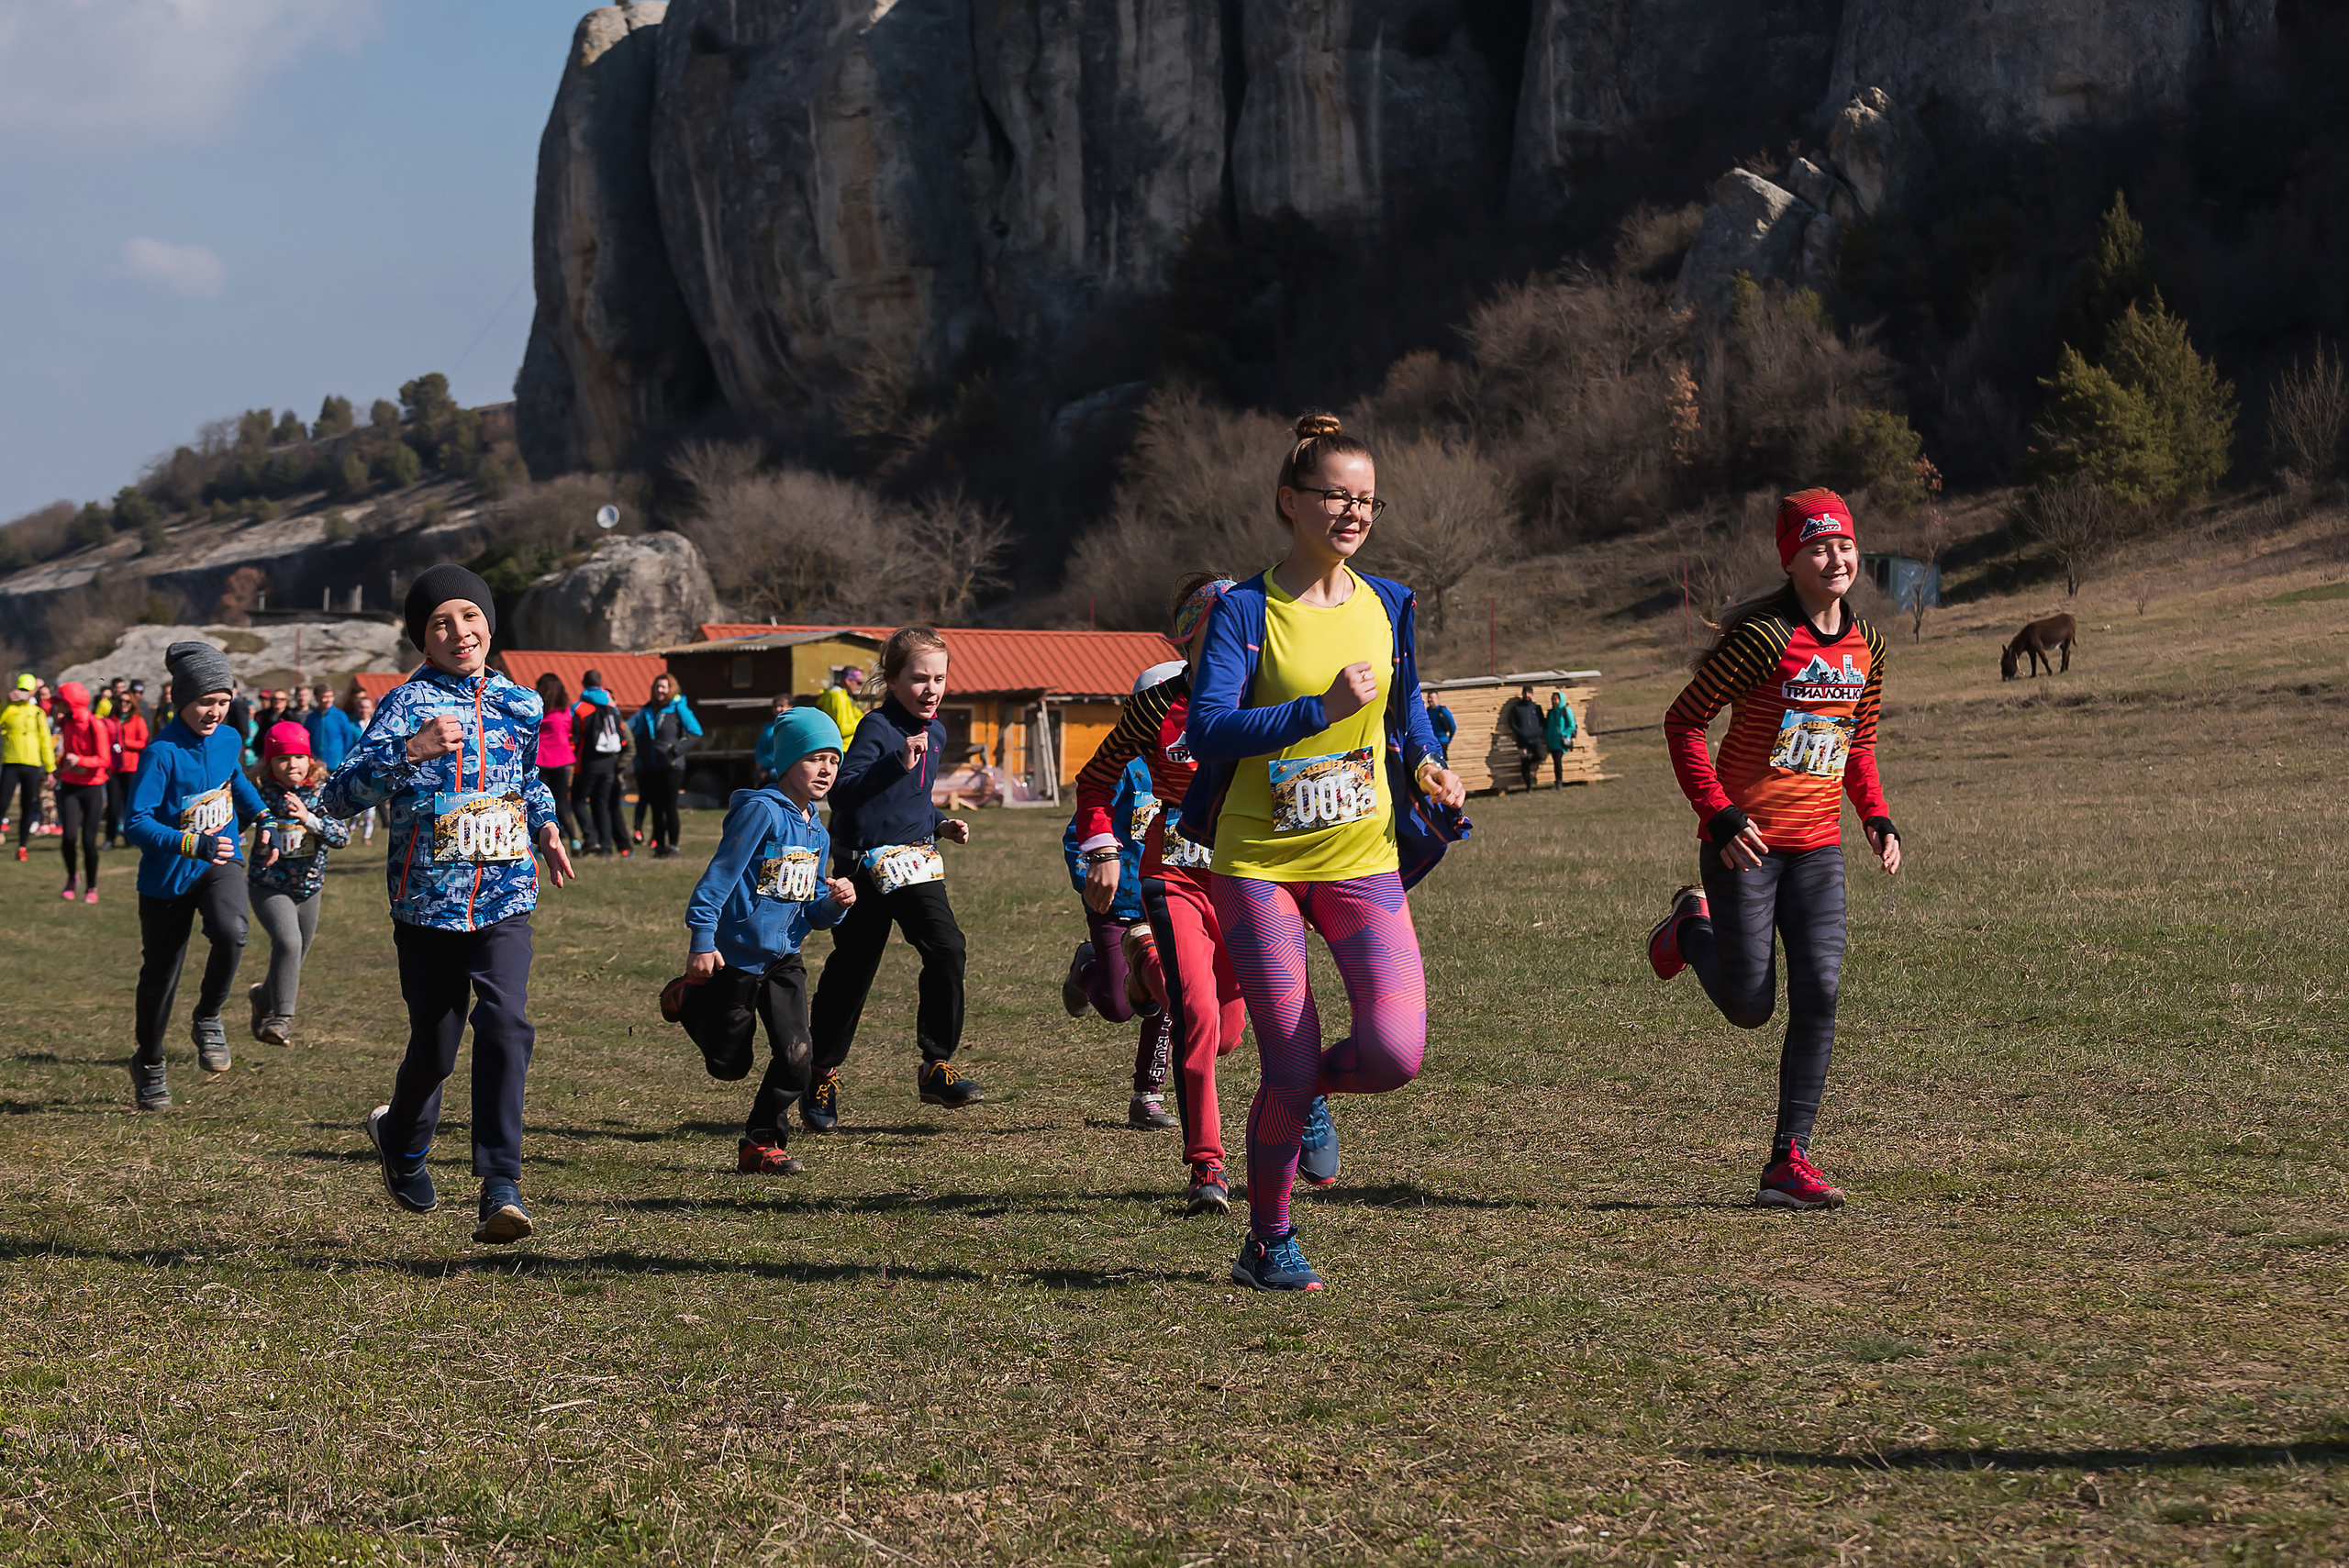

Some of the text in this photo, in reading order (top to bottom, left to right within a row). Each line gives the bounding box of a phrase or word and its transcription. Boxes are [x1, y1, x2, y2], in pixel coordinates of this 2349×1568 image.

[1787, 729, 1837, 771] 011
[450, 795, 462, 804] KM
[1296, 772, 1357, 823] 005
[459, 812, 512, 856] 003
